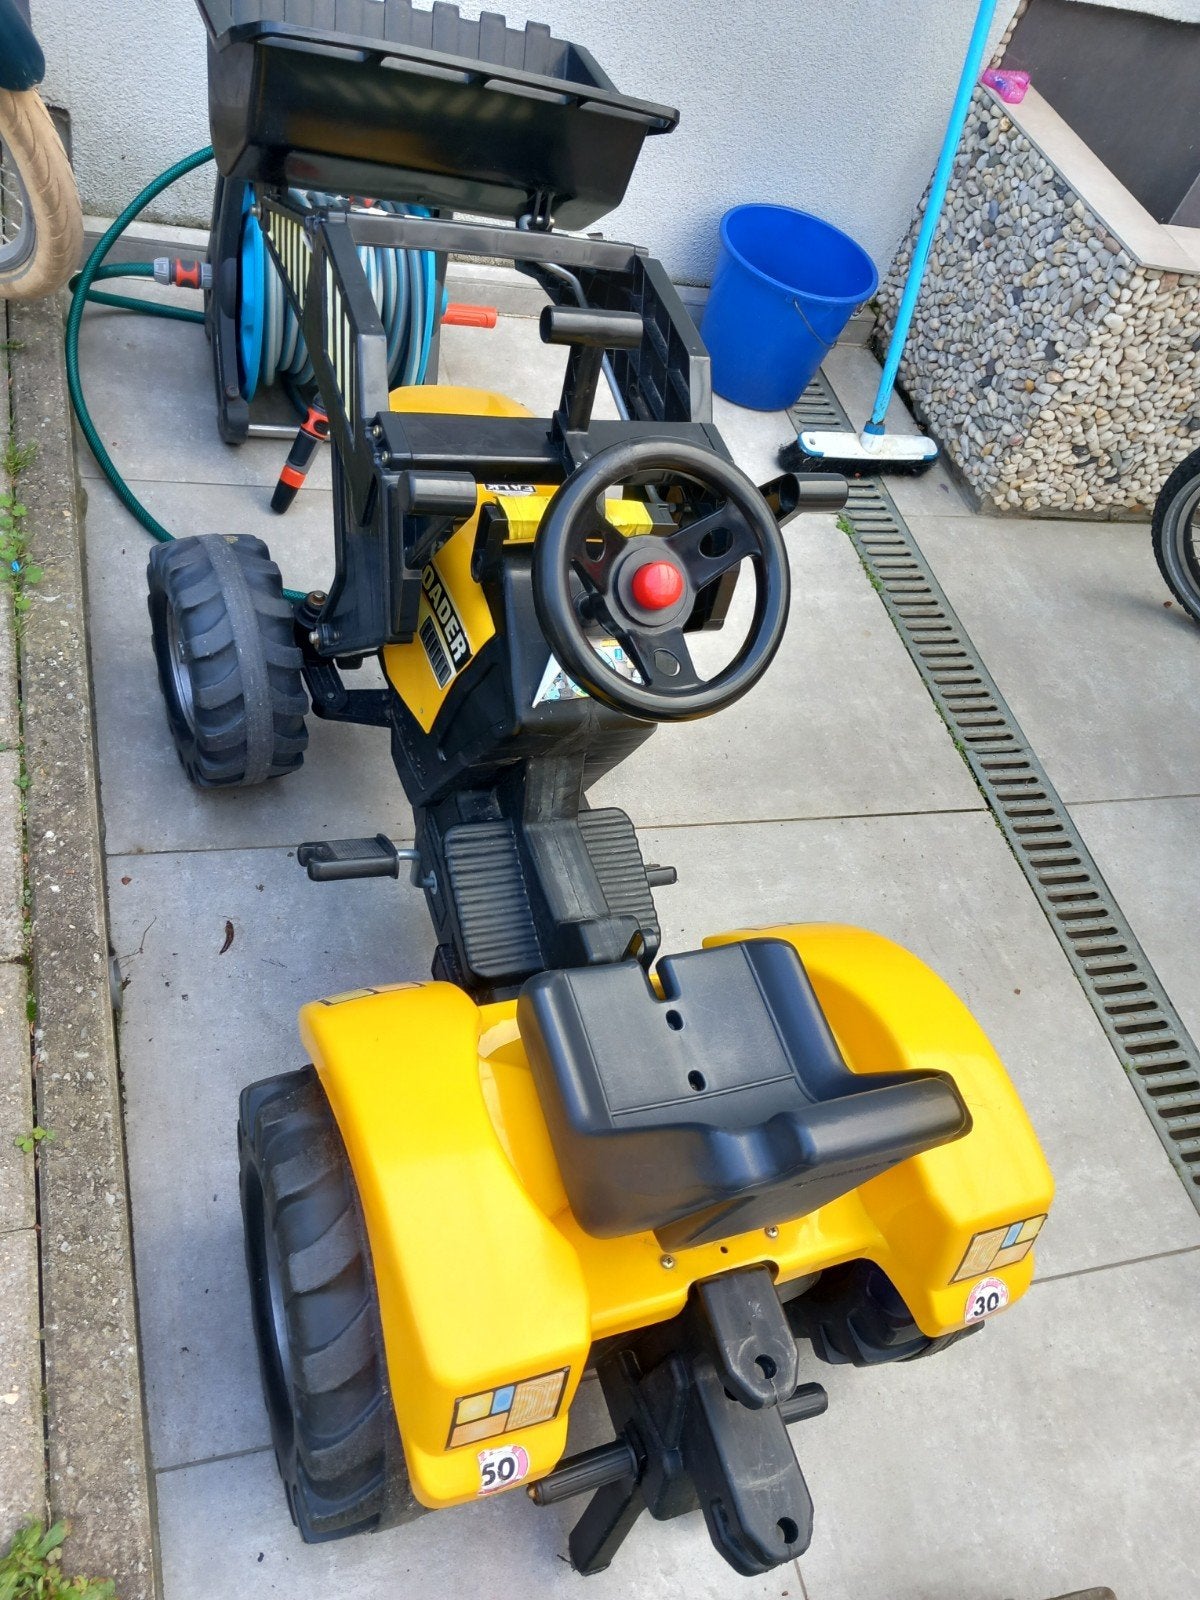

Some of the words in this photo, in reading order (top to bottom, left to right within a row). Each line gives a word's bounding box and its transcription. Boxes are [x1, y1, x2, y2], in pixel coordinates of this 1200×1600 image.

[421, 564, 467, 663] OADER
[973, 1292, 999, 1317] 30
[481, 1456, 516, 1487] 50
